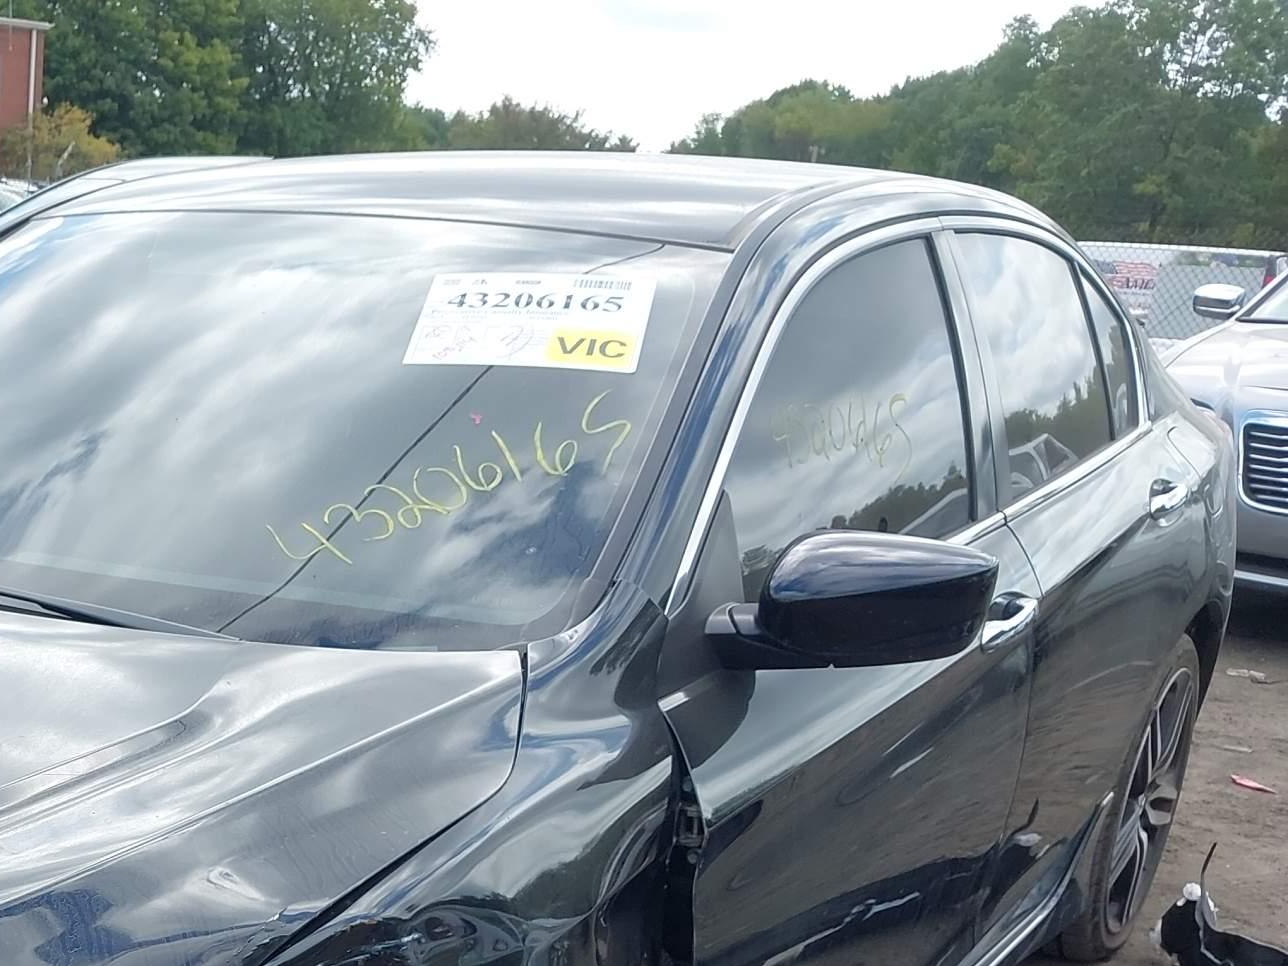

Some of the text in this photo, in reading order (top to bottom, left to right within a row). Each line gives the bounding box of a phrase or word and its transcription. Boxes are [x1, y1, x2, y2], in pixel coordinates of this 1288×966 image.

[447, 292, 625, 312] 43206165
[557, 336, 627, 358] VIC
[266, 389, 632, 564] 43206165
